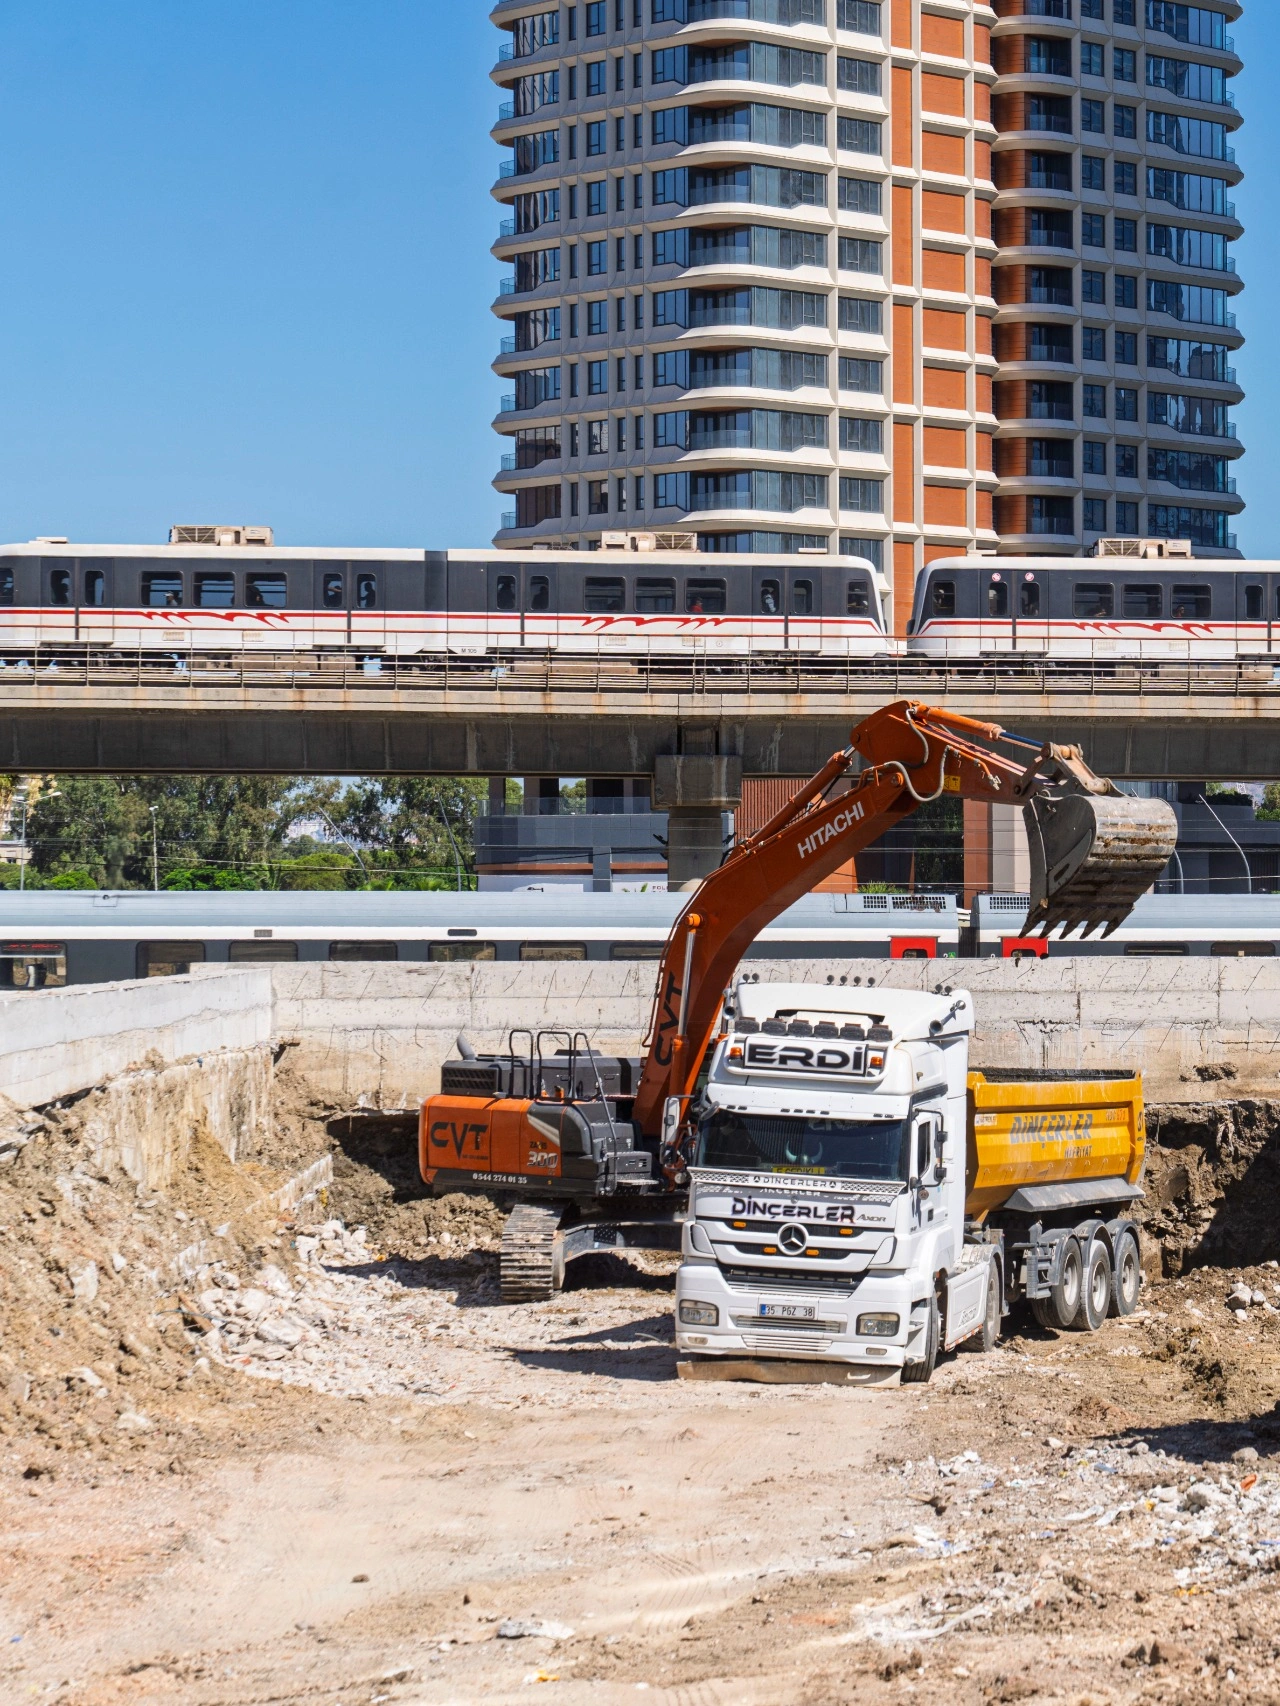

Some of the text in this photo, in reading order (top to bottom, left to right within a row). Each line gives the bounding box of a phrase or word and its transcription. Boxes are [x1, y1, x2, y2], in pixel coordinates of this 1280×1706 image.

[797, 801, 865, 858] HITACHI
[654, 971, 682, 1066] CVT
[746, 1043, 865, 1071] ERDİ
[430, 1121, 489, 1160] CVT
[1009, 1113, 1093, 1149] DİNÇERLER
[527, 1151, 558, 1169] 300
[472, 1173, 492, 1181] 0544
[493, 1174, 507, 1182] 274
[508, 1175, 517, 1184] 01
[763, 1176, 827, 1188] DİNÇERLER
[731, 1195, 856, 1224] DİNÇERLER
[766, 1305, 813, 1317] 35 PGZ 38
